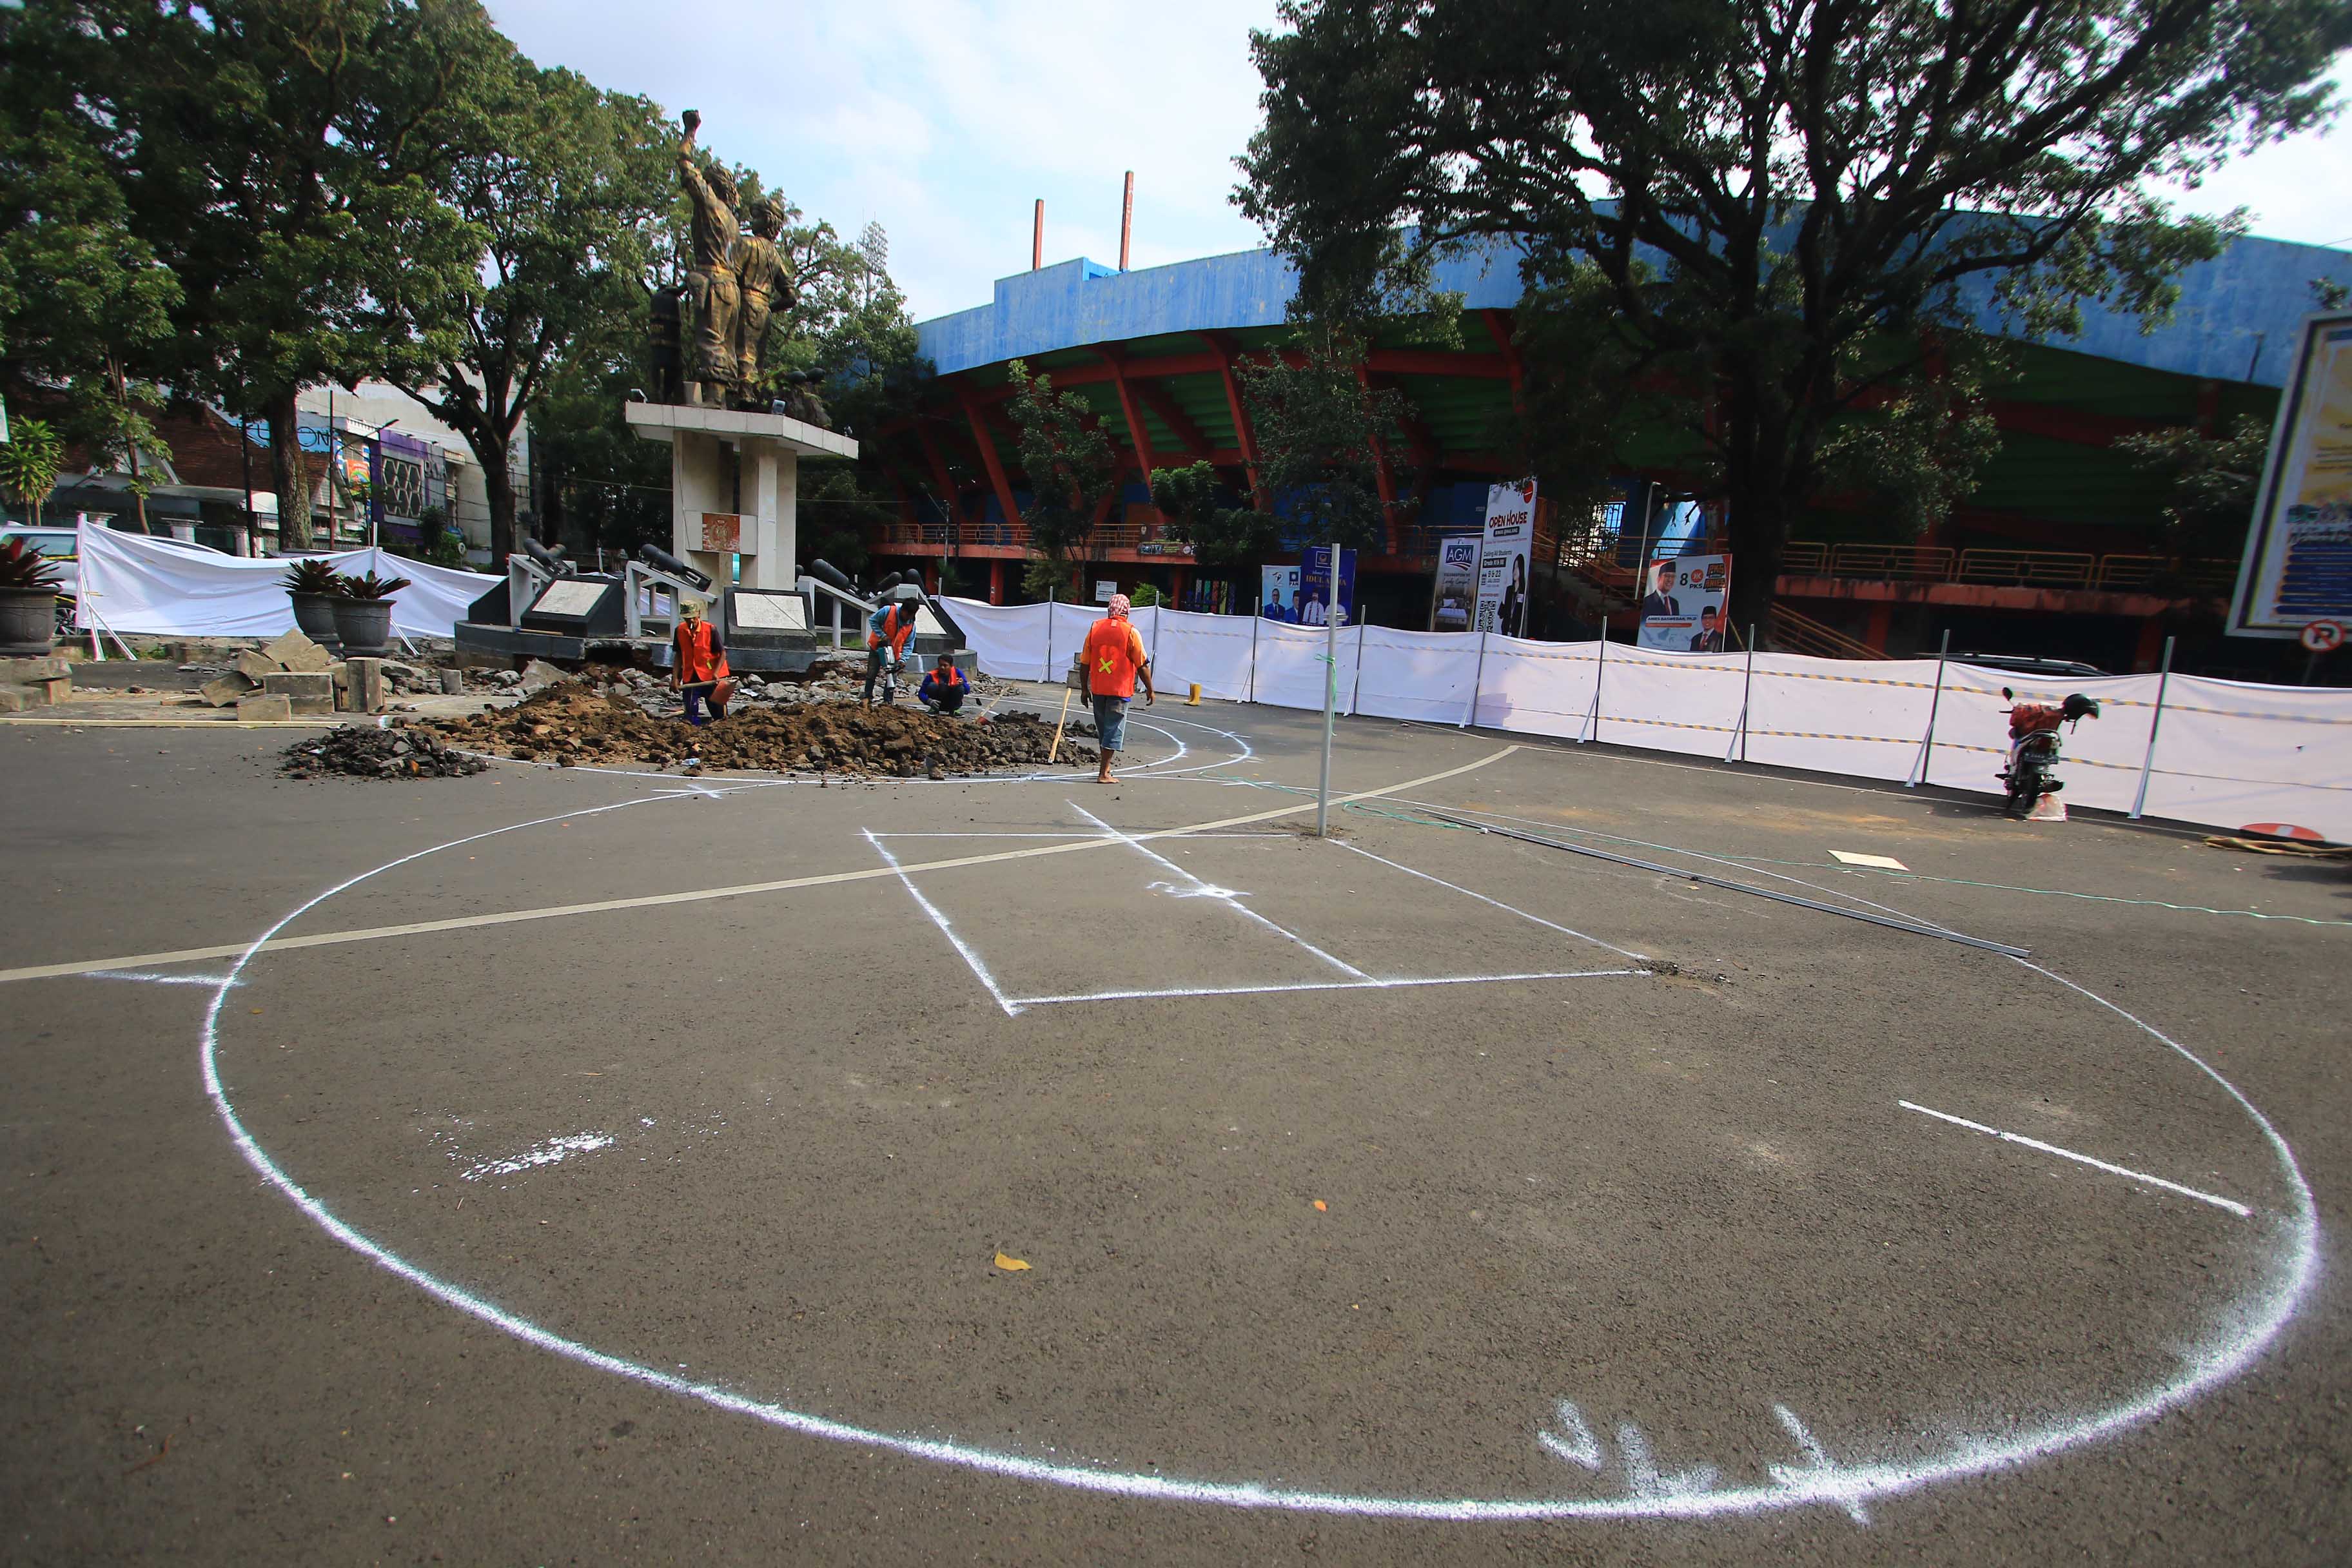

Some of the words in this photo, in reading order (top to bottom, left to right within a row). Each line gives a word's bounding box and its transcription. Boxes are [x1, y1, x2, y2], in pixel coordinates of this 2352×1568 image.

[1489, 514, 1506, 528] OPEN
[1507, 509, 1528, 526] HOUSE
[1447, 548, 1472, 561] AGM
[1680, 573, 1688, 586] 8
